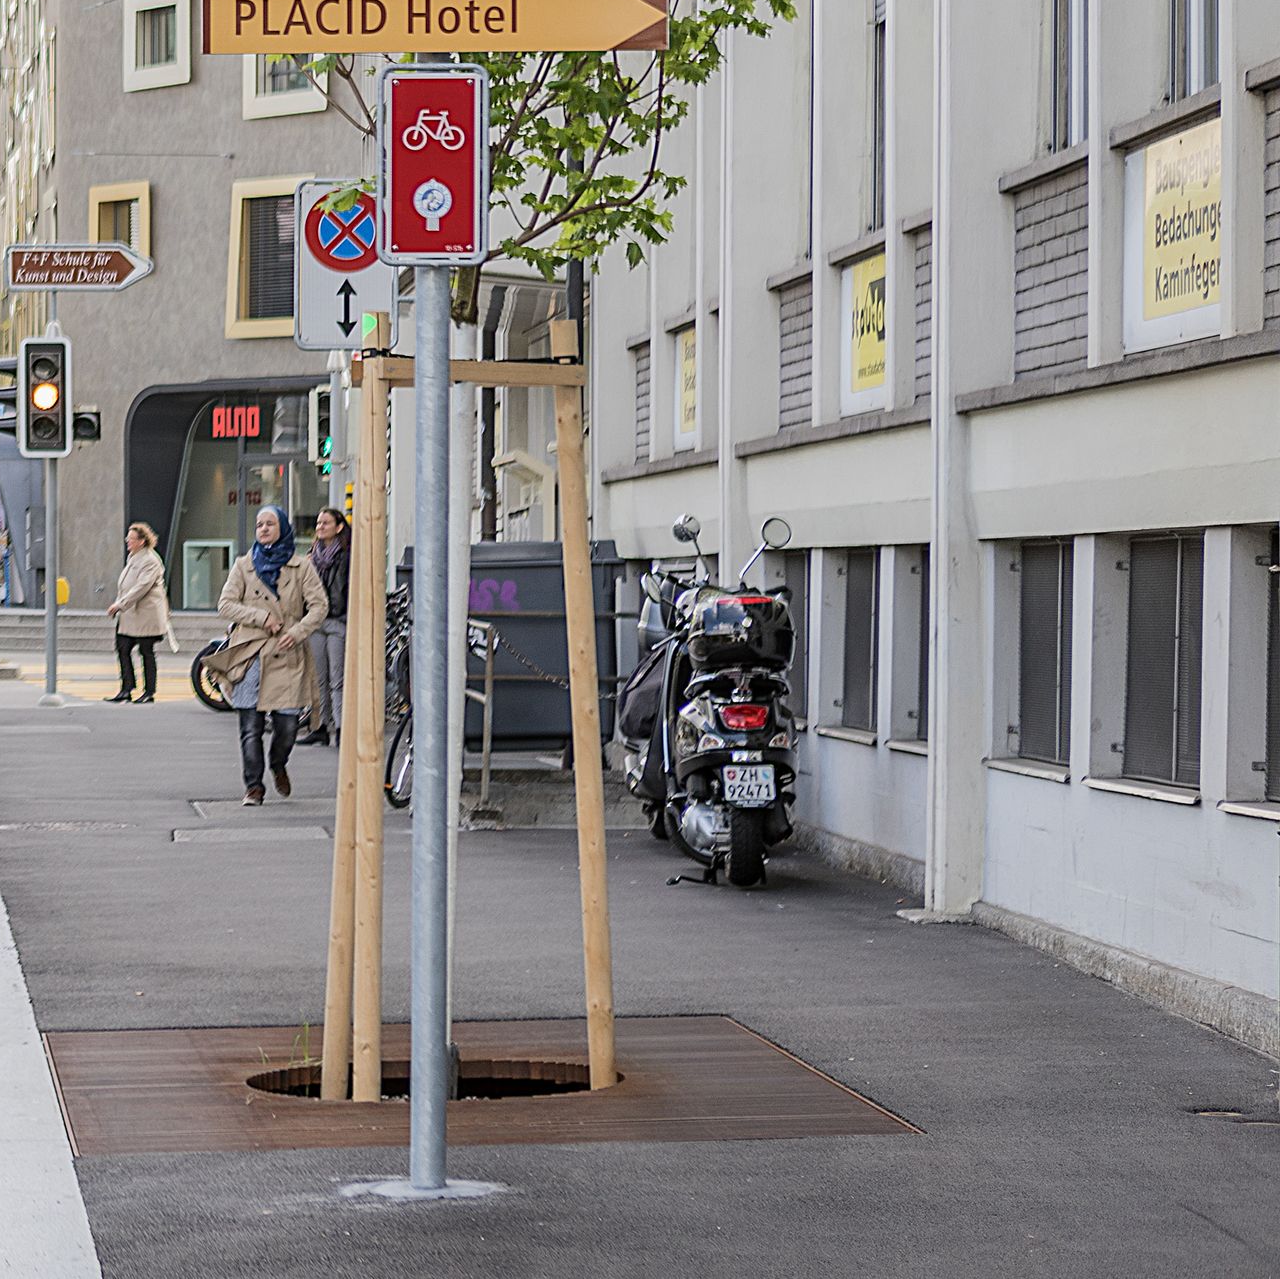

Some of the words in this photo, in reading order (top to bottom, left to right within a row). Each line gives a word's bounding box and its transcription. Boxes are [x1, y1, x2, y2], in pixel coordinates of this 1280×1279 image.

[21, 252, 49, 267] F+F
[51, 252, 90, 267] Schule
[90, 252, 112, 269] für
[14, 268, 49, 283] Kunst
[51, 268, 74, 283] und
[76, 268, 118, 285] Design
[212, 405, 260, 438] ALNO
[228, 489, 262, 506] ANO
[739, 769, 758, 782] ZH
[727, 784, 772, 798] 92471
